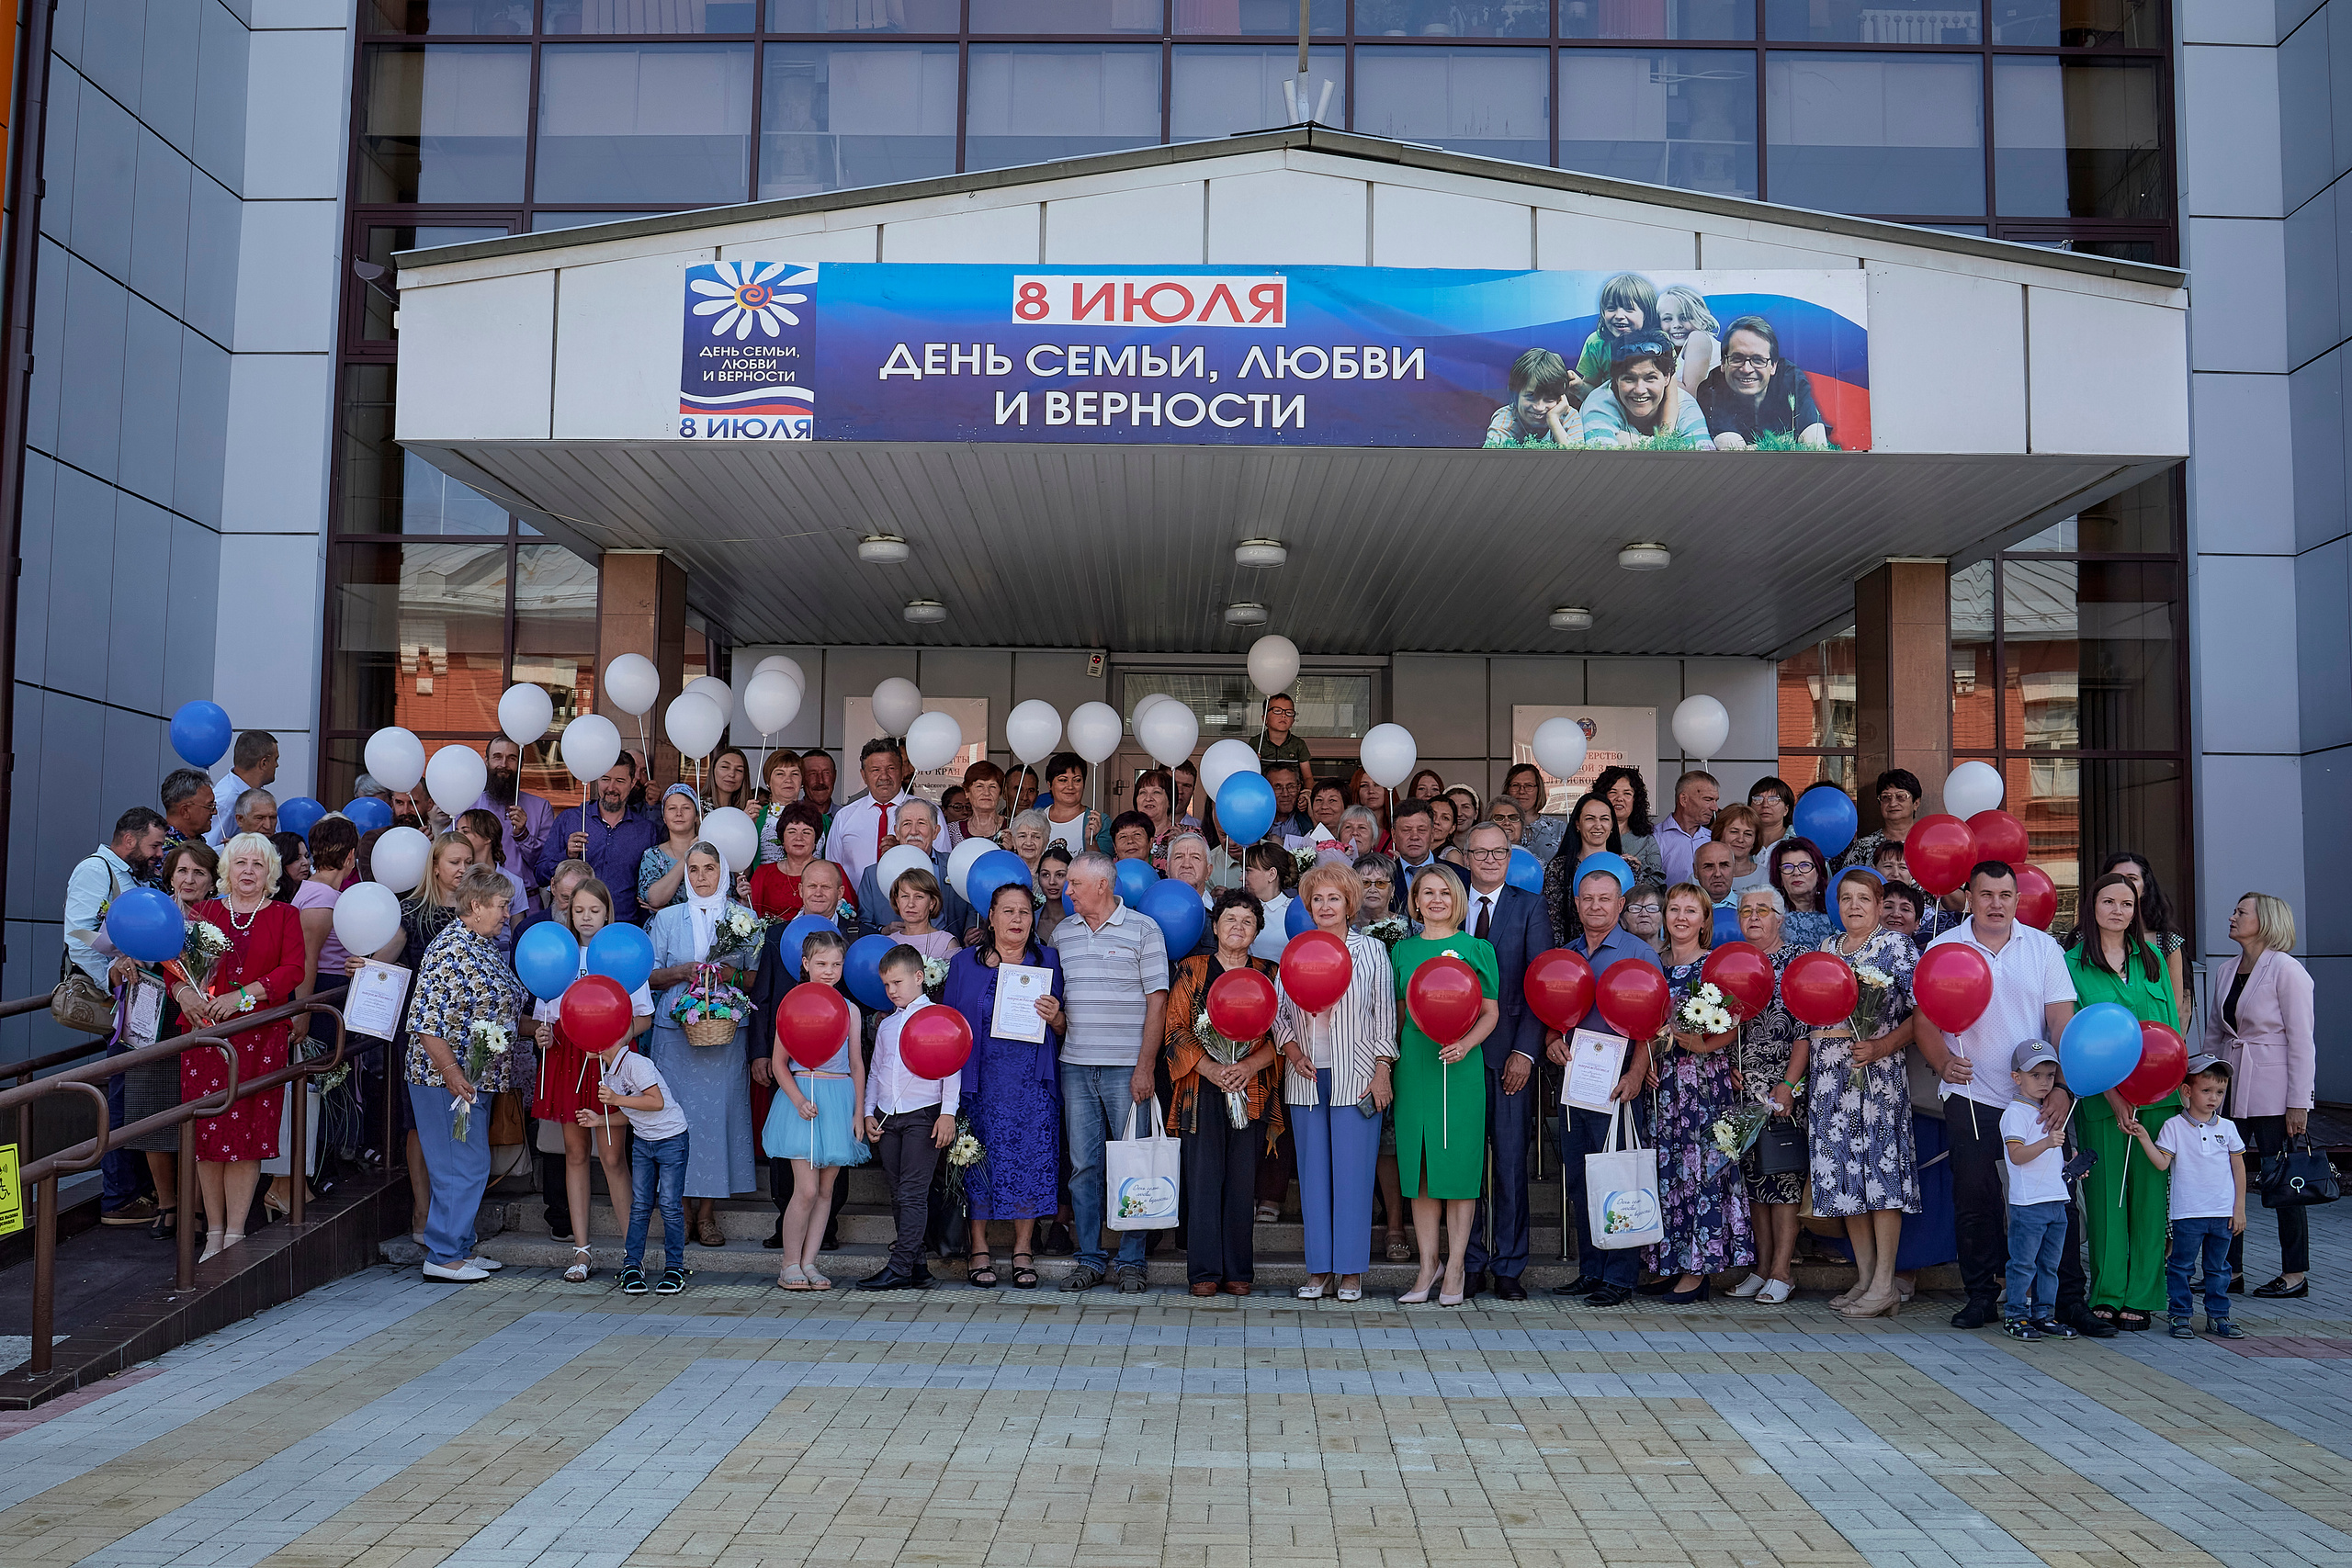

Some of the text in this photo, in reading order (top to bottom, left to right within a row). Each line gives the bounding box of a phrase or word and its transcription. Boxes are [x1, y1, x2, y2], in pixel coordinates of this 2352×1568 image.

[1015, 281, 1283, 323] 8 ИЮЛЯ
[699, 345, 800, 359] ДЕНЬ СЕМЬИ,
[878, 342, 1426, 384] ДЕНЬ СЕМЬИ, ЛЮБВИ
[721, 358, 777, 370] ЛЮБВИ
[703, 370, 796, 382] И ВЕРНОСТИ
[994, 389, 1306, 429] И ВЕРНОСТИ
[680, 417, 811, 439] 8 ИЮЛЯ
